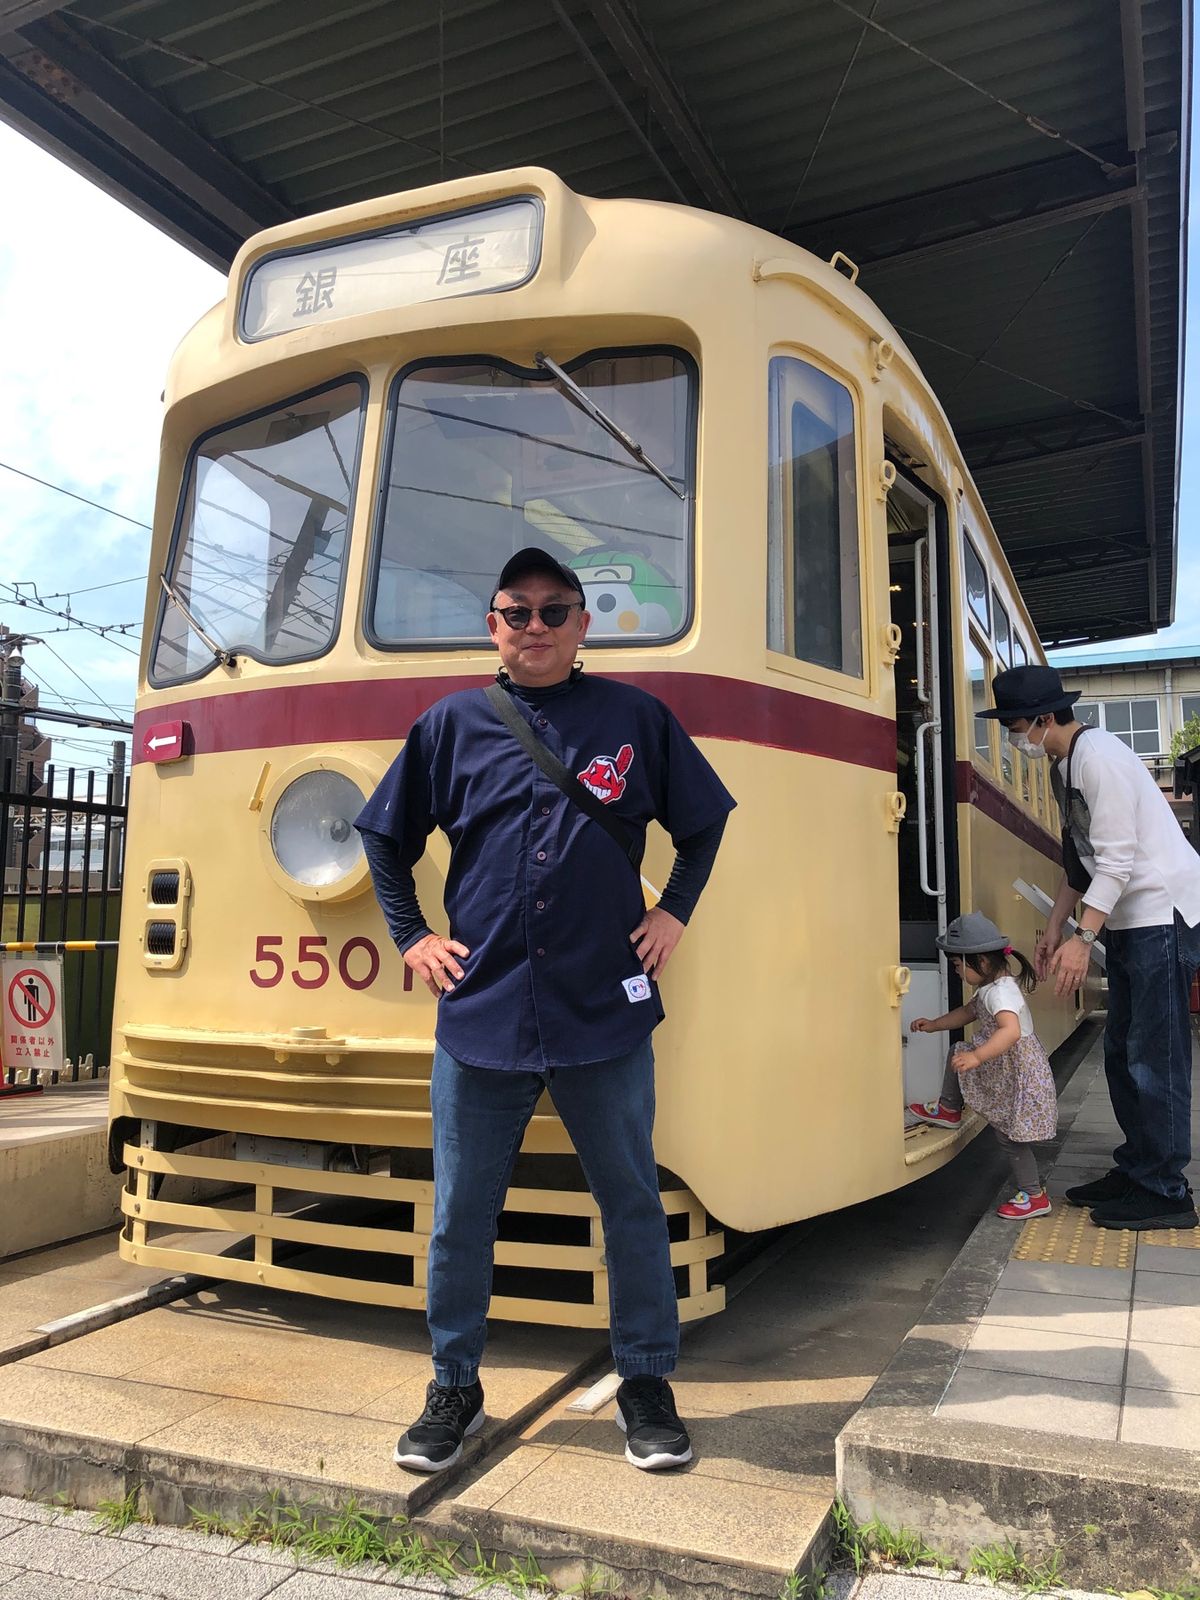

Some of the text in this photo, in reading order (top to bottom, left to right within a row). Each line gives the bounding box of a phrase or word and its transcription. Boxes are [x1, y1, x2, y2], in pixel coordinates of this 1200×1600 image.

[10, 1035, 54, 1046] 関係者以外
[15, 1047, 50, 1058] 立入禁止
